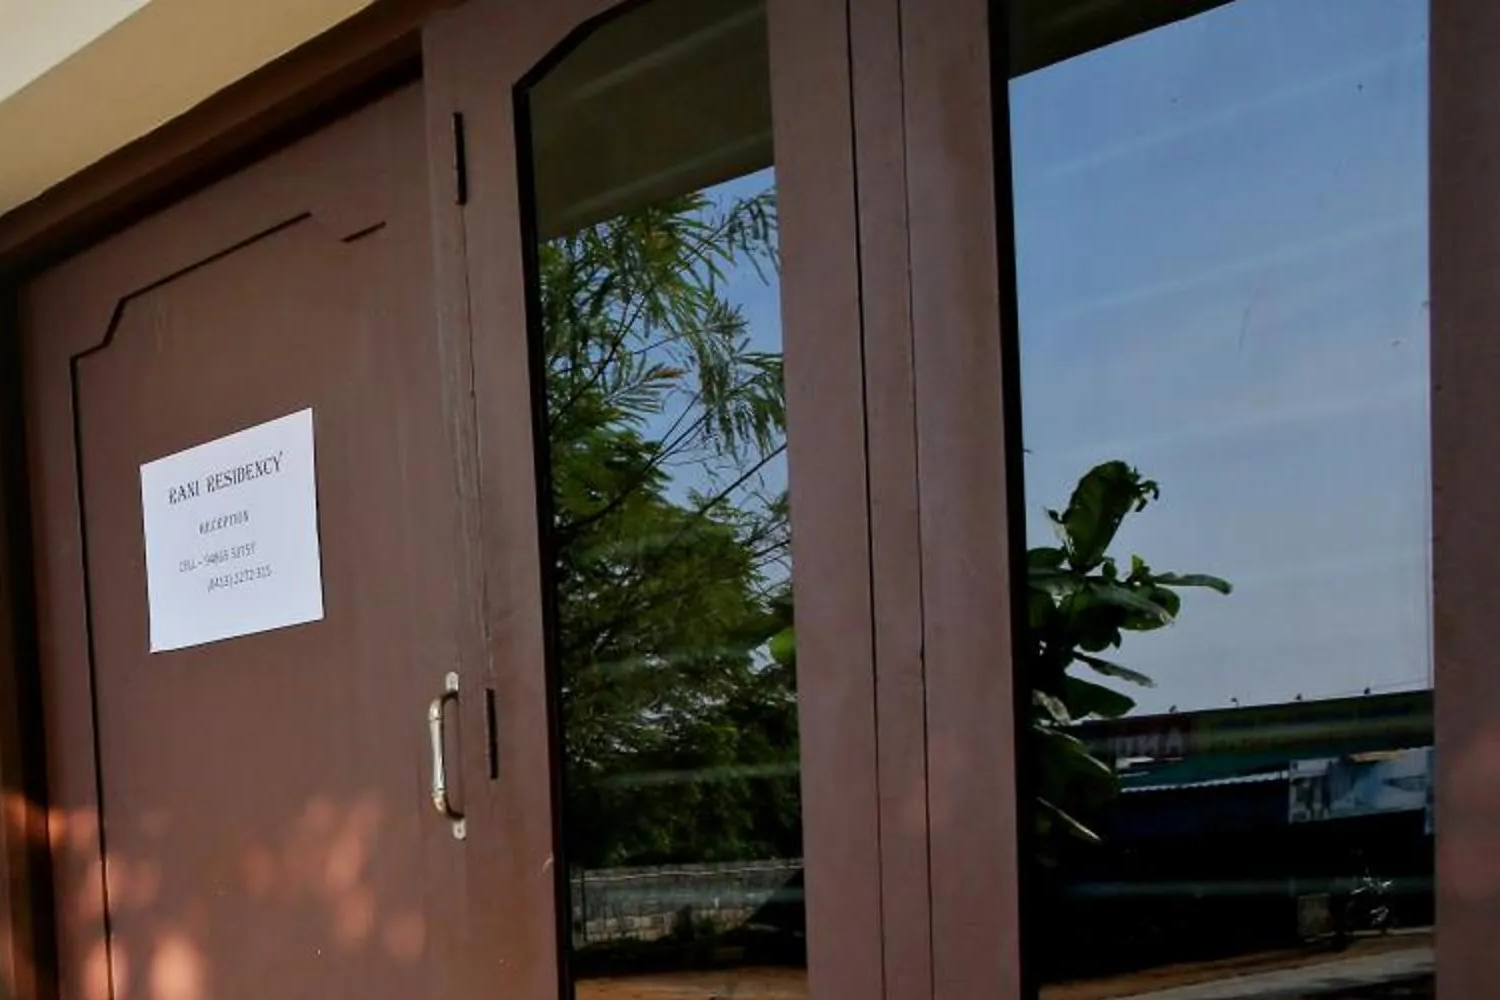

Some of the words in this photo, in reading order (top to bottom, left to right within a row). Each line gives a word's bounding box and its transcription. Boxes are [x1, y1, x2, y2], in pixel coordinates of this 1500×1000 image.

[168, 480, 200, 505] RANI
[206, 451, 283, 493] RESIDENCY
[198, 510, 250, 535] RECEPTION
